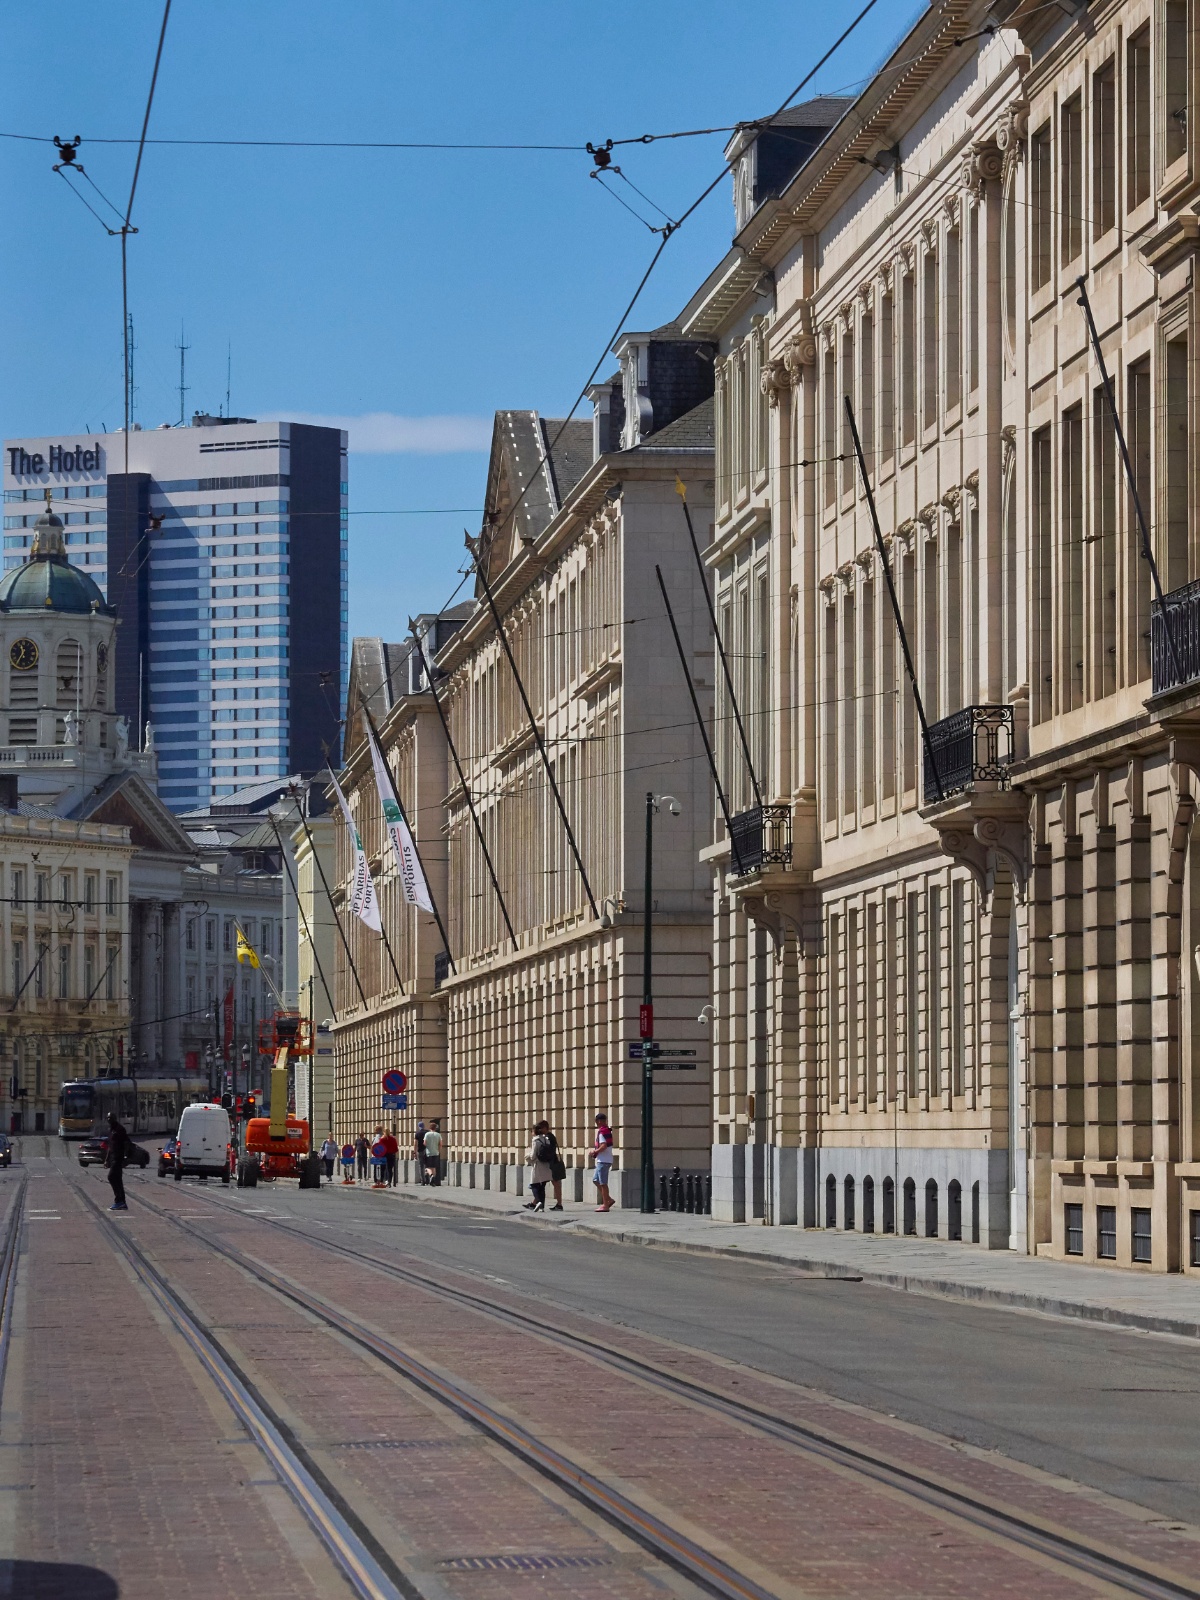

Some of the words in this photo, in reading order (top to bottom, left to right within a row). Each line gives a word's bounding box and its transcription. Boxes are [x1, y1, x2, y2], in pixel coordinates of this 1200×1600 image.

[7, 446, 43, 475] The
[49, 442, 100, 472] Hotel
[355, 855, 365, 901] PARIBAS
